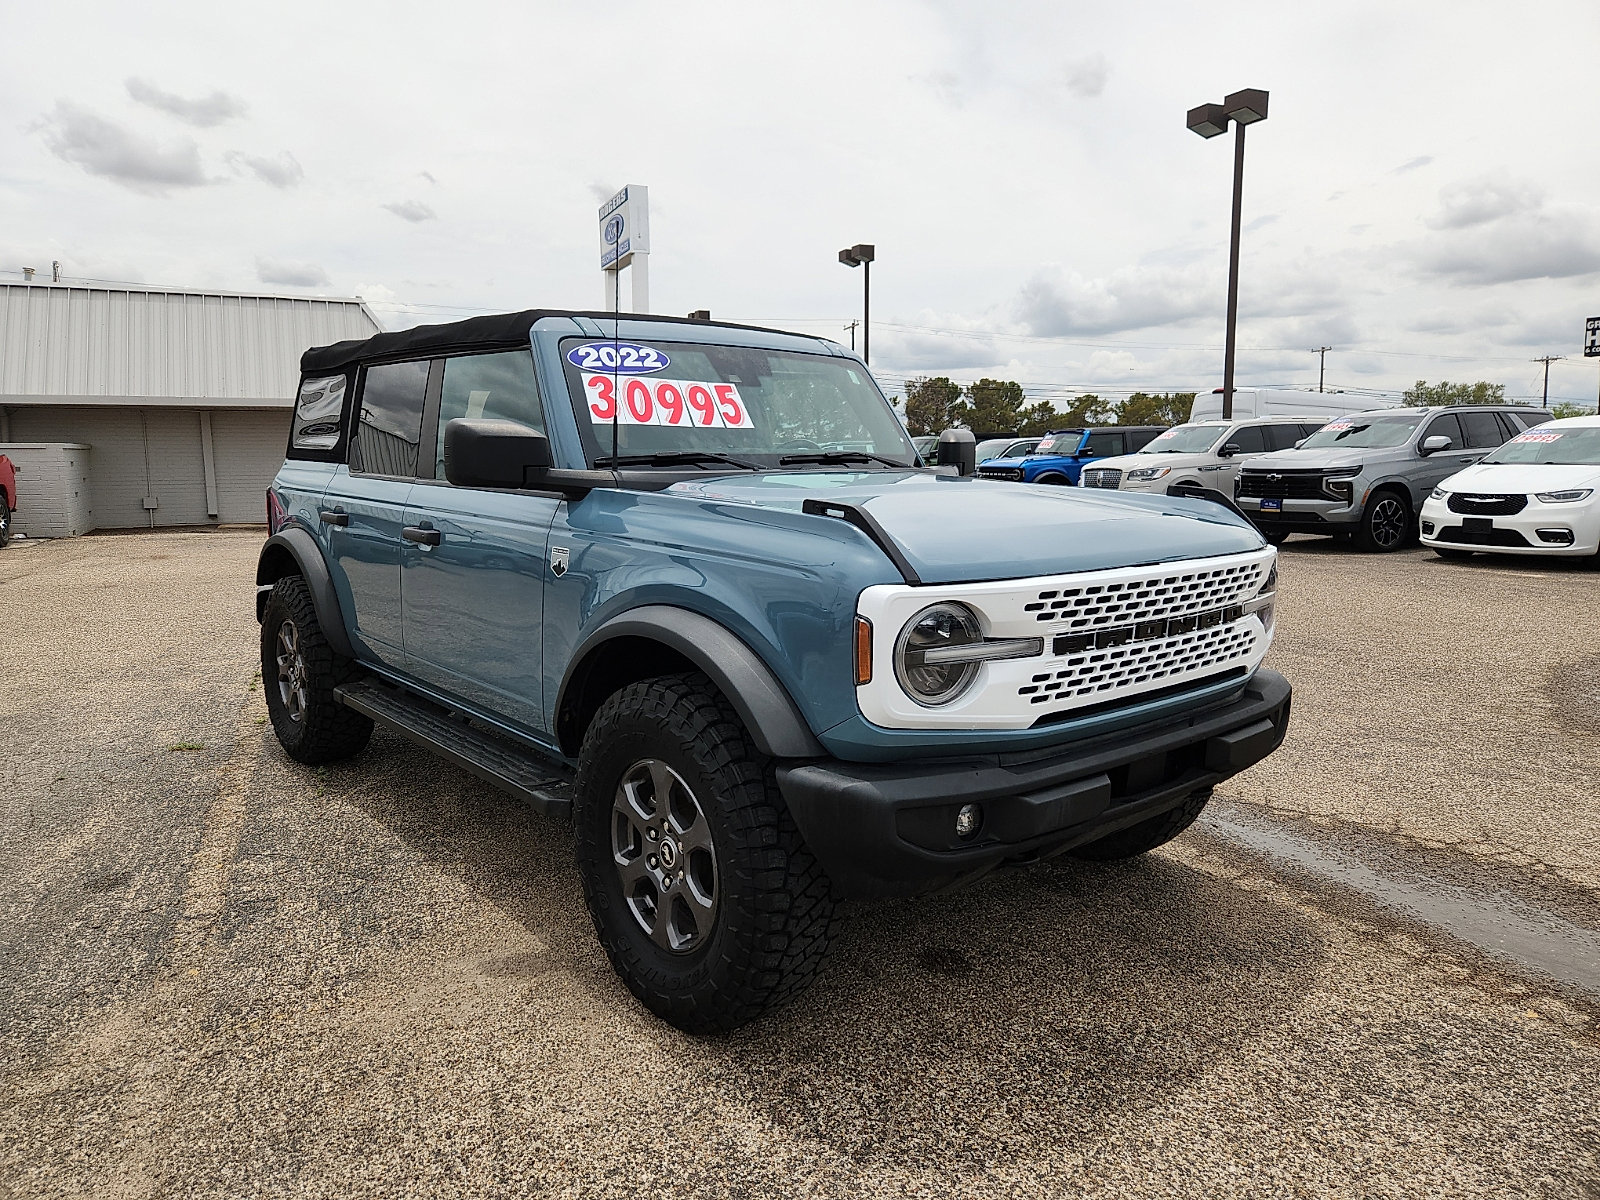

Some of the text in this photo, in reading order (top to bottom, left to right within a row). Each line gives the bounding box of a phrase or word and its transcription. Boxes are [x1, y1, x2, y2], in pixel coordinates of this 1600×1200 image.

[578, 346, 663, 368] 2022
[588, 375, 744, 426] 30995
[1053, 604, 1243, 656] BRONCO
